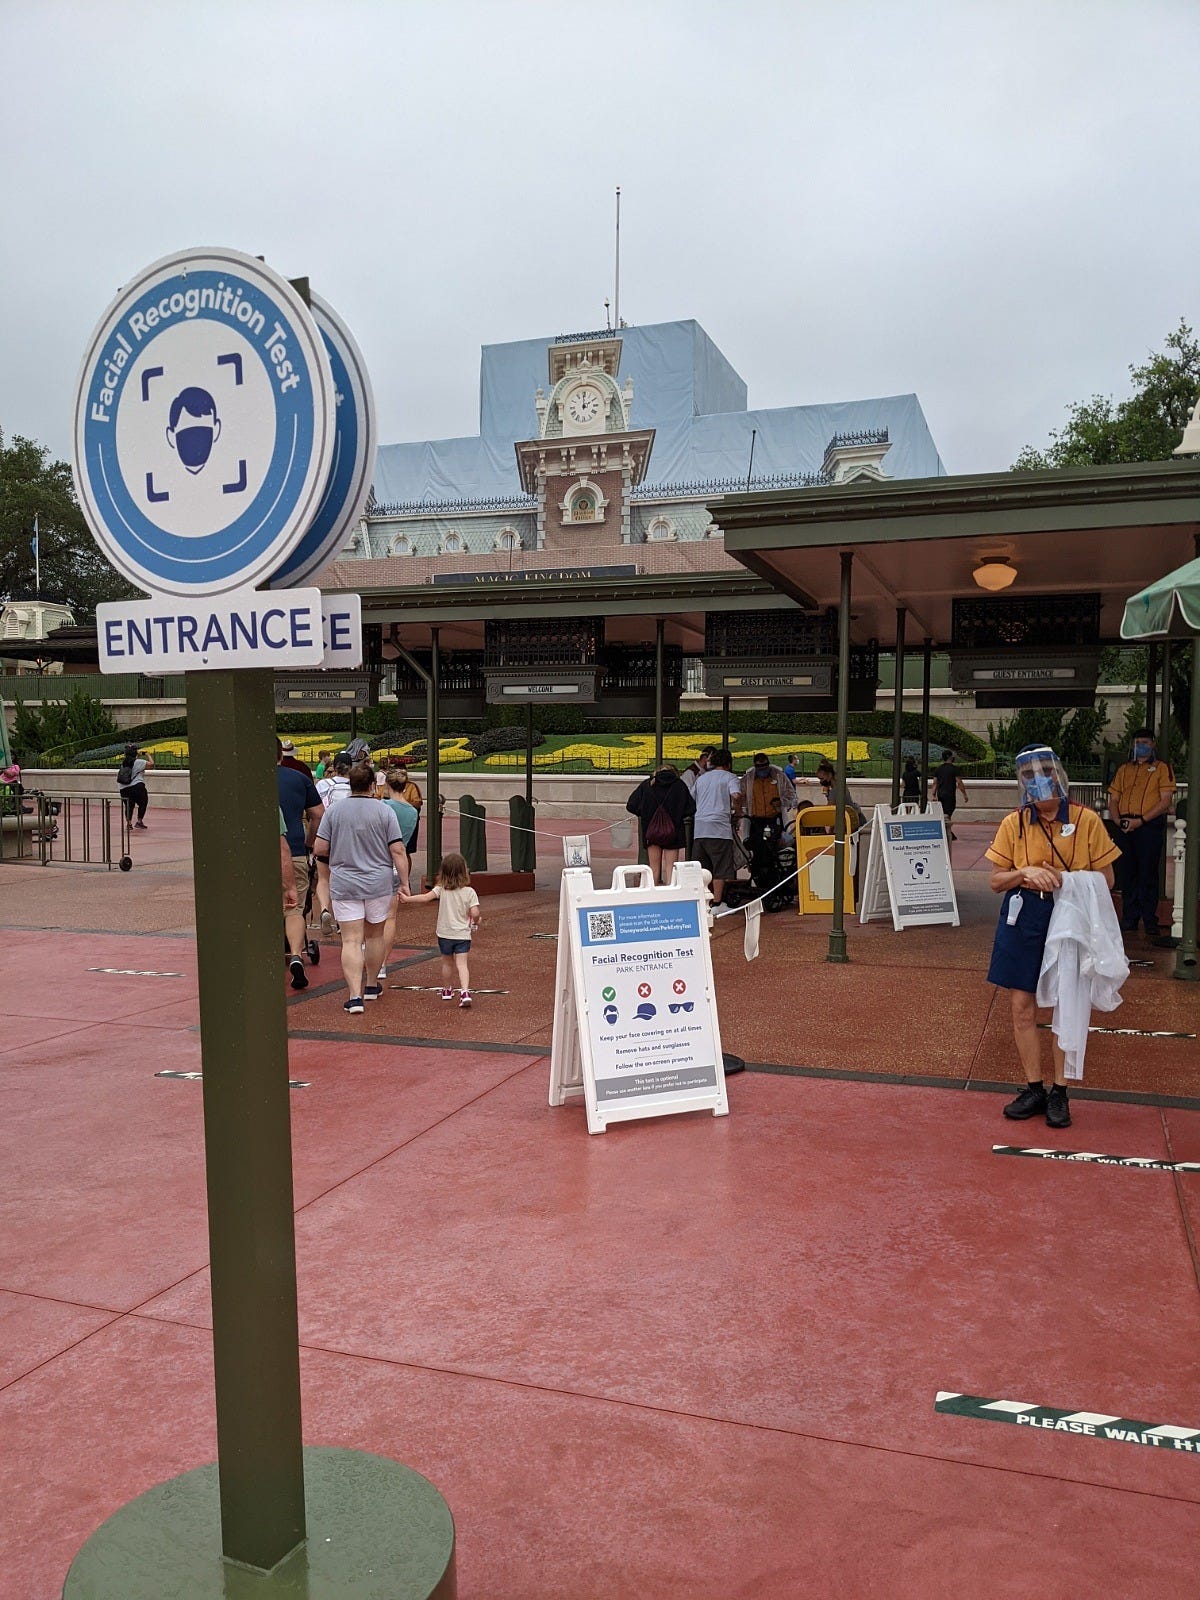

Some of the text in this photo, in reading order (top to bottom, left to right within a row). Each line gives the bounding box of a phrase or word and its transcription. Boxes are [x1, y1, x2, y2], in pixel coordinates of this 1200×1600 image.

[91, 332, 133, 423] Facial
[128, 282, 266, 341] Recognition
[264, 321, 300, 394] Test
[105, 608, 313, 657] ENTRANCE
[993, 669, 1054, 679] GUEST ENTRANCE
[741, 677, 794, 686] GUEST ENTRANCE
[527, 685, 553, 693] WELCOME
[592, 948, 694, 965] Facial Recognition Test
[616, 962, 673, 974] PARK ENTRANCE
[641, 1029, 665, 1037] covering
[662, 1041, 690, 1050] sunglasses
[644, 1058, 671, 1067] on-screen
[671, 1056, 694, 1065] prompts
[660, 1074, 678, 1082] optional
[1042, 1153, 1185, 1172] PLEASE WAIT HERE
[1016, 1413, 1096, 1436] PLEASE
[1104, 1427, 1164, 1447] WAIT
